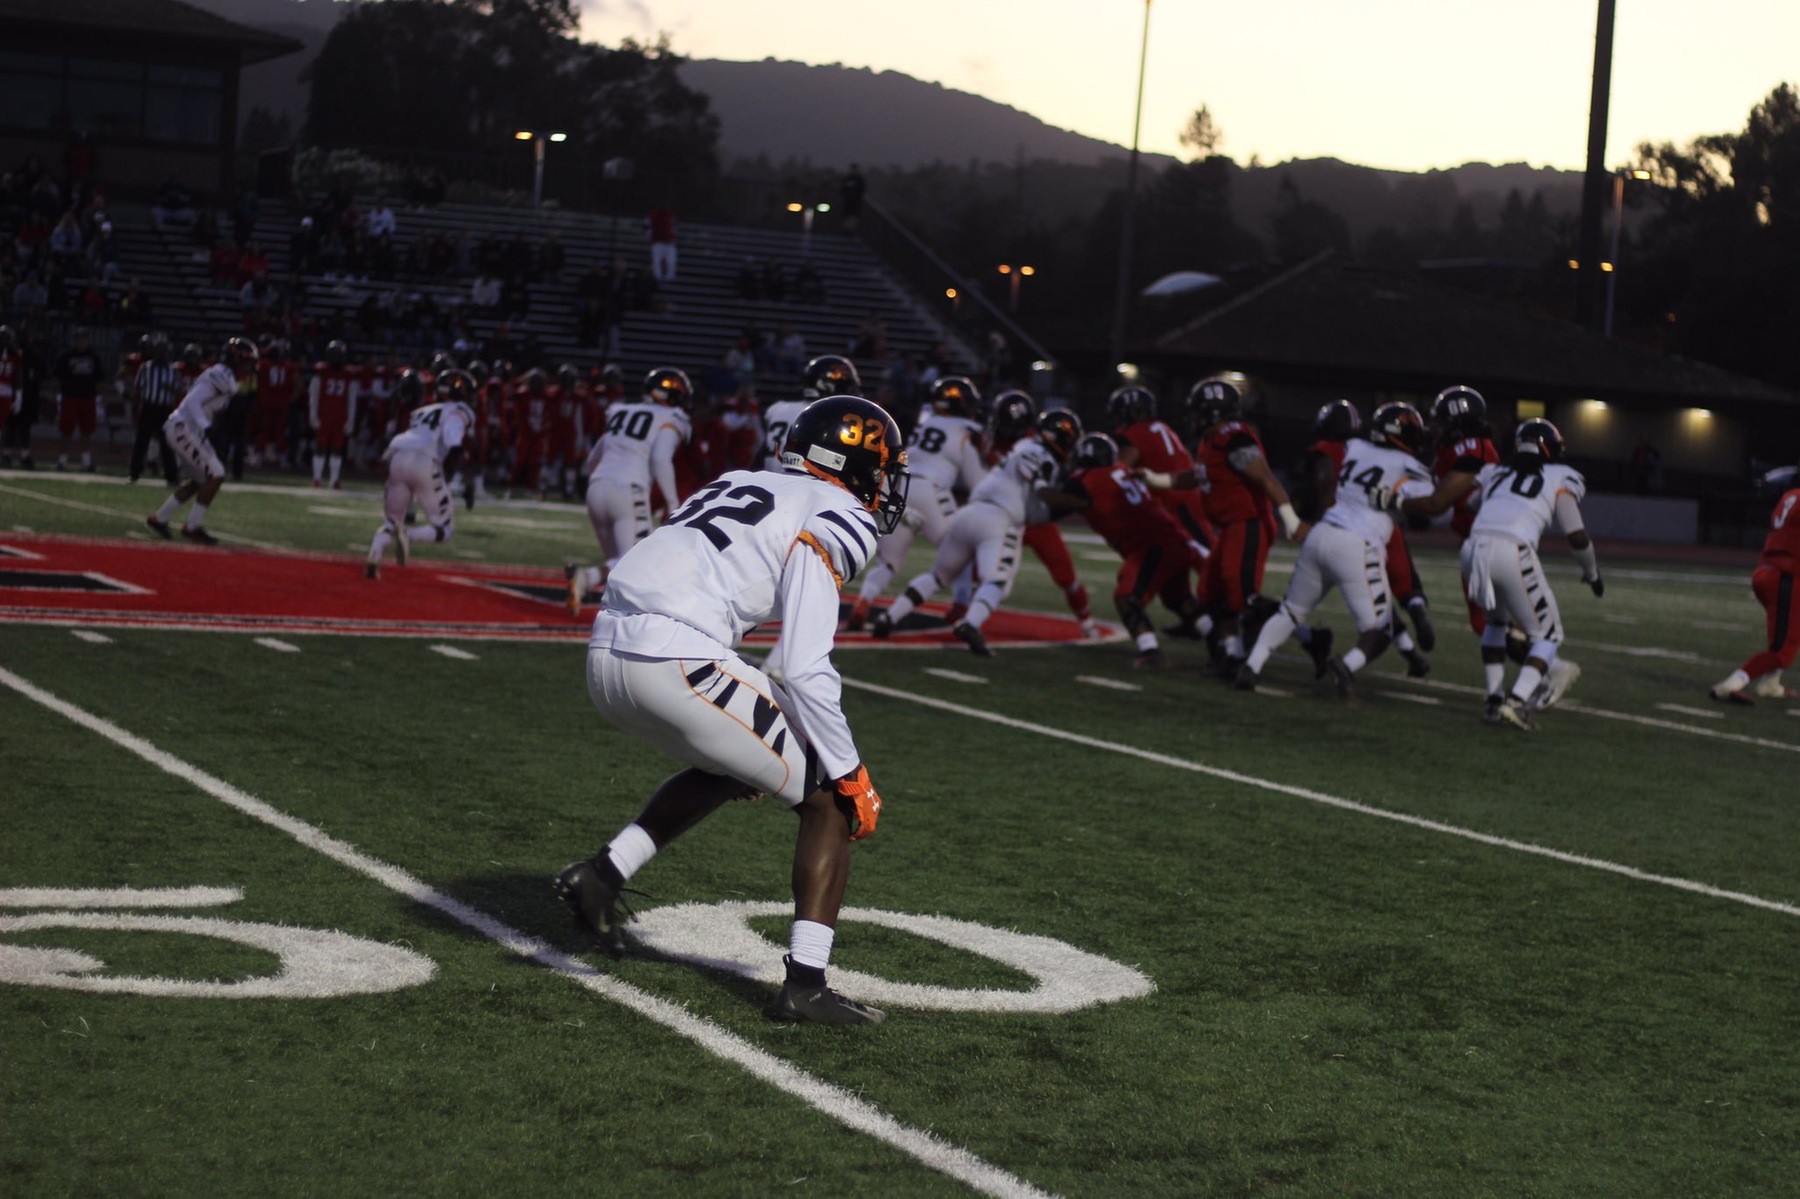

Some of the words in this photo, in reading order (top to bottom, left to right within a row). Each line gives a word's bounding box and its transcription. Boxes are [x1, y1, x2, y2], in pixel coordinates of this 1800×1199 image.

[608, 410, 653, 440] 40
[840, 413, 884, 453] 32
[662, 480, 775, 553] 32
